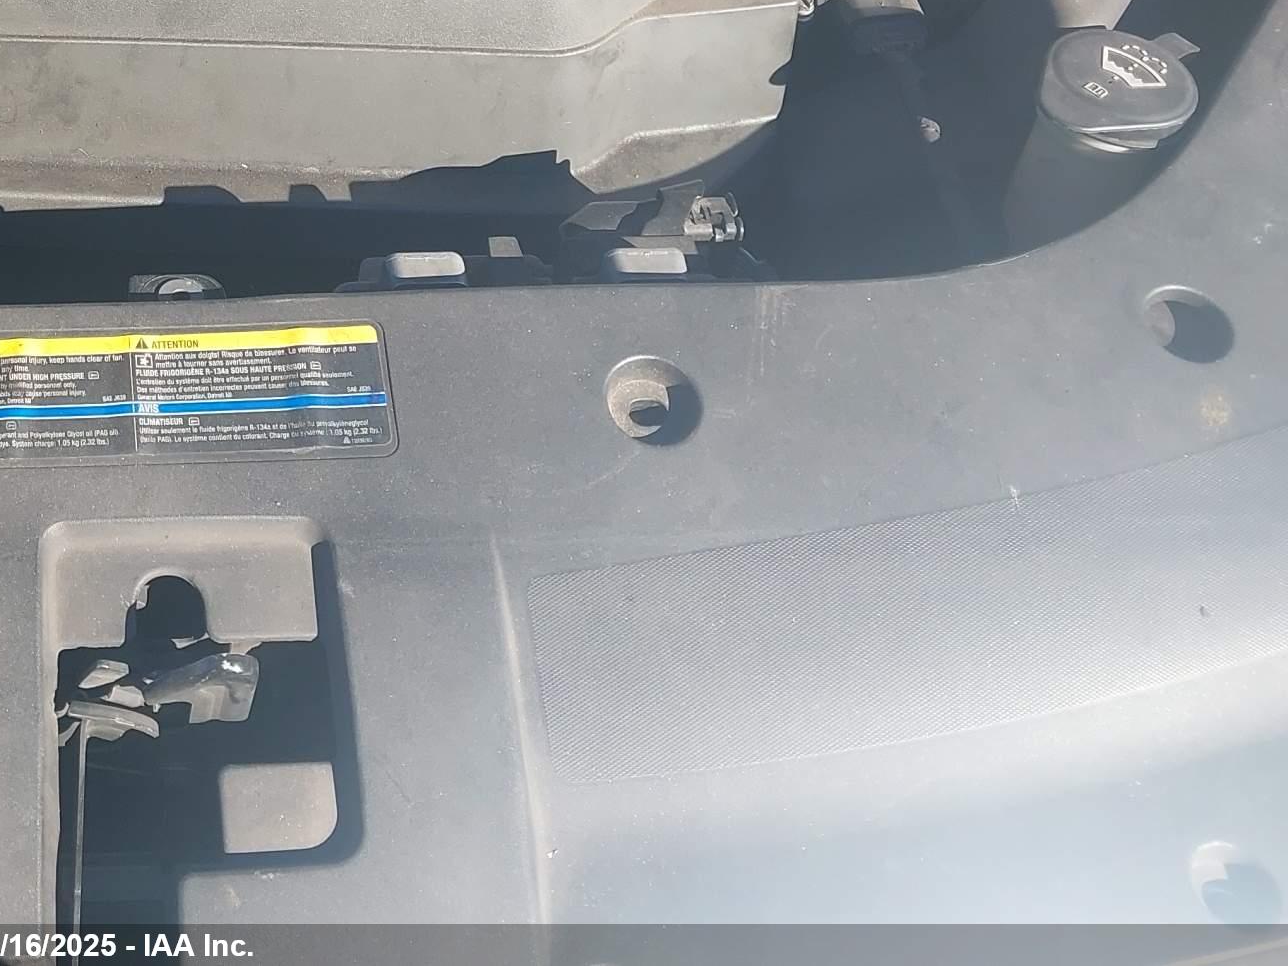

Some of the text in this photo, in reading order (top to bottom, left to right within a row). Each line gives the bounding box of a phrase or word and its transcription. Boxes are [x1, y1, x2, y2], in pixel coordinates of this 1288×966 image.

[152, 340, 199, 349] ATTENTION
[298, 346, 331, 354] ventilateur
[29, 356, 48, 365] injury,
[49, 356, 65, 364] keep
[9, 373, 31, 381] UNDER
[135, 369, 159, 377] FLUIDE
[160, 368, 204, 376] FRIGORIGÈNE
[138, 404, 159, 413] AVIS
[12, 440, 33, 448] System
[72, 439, 79, 447] kg
